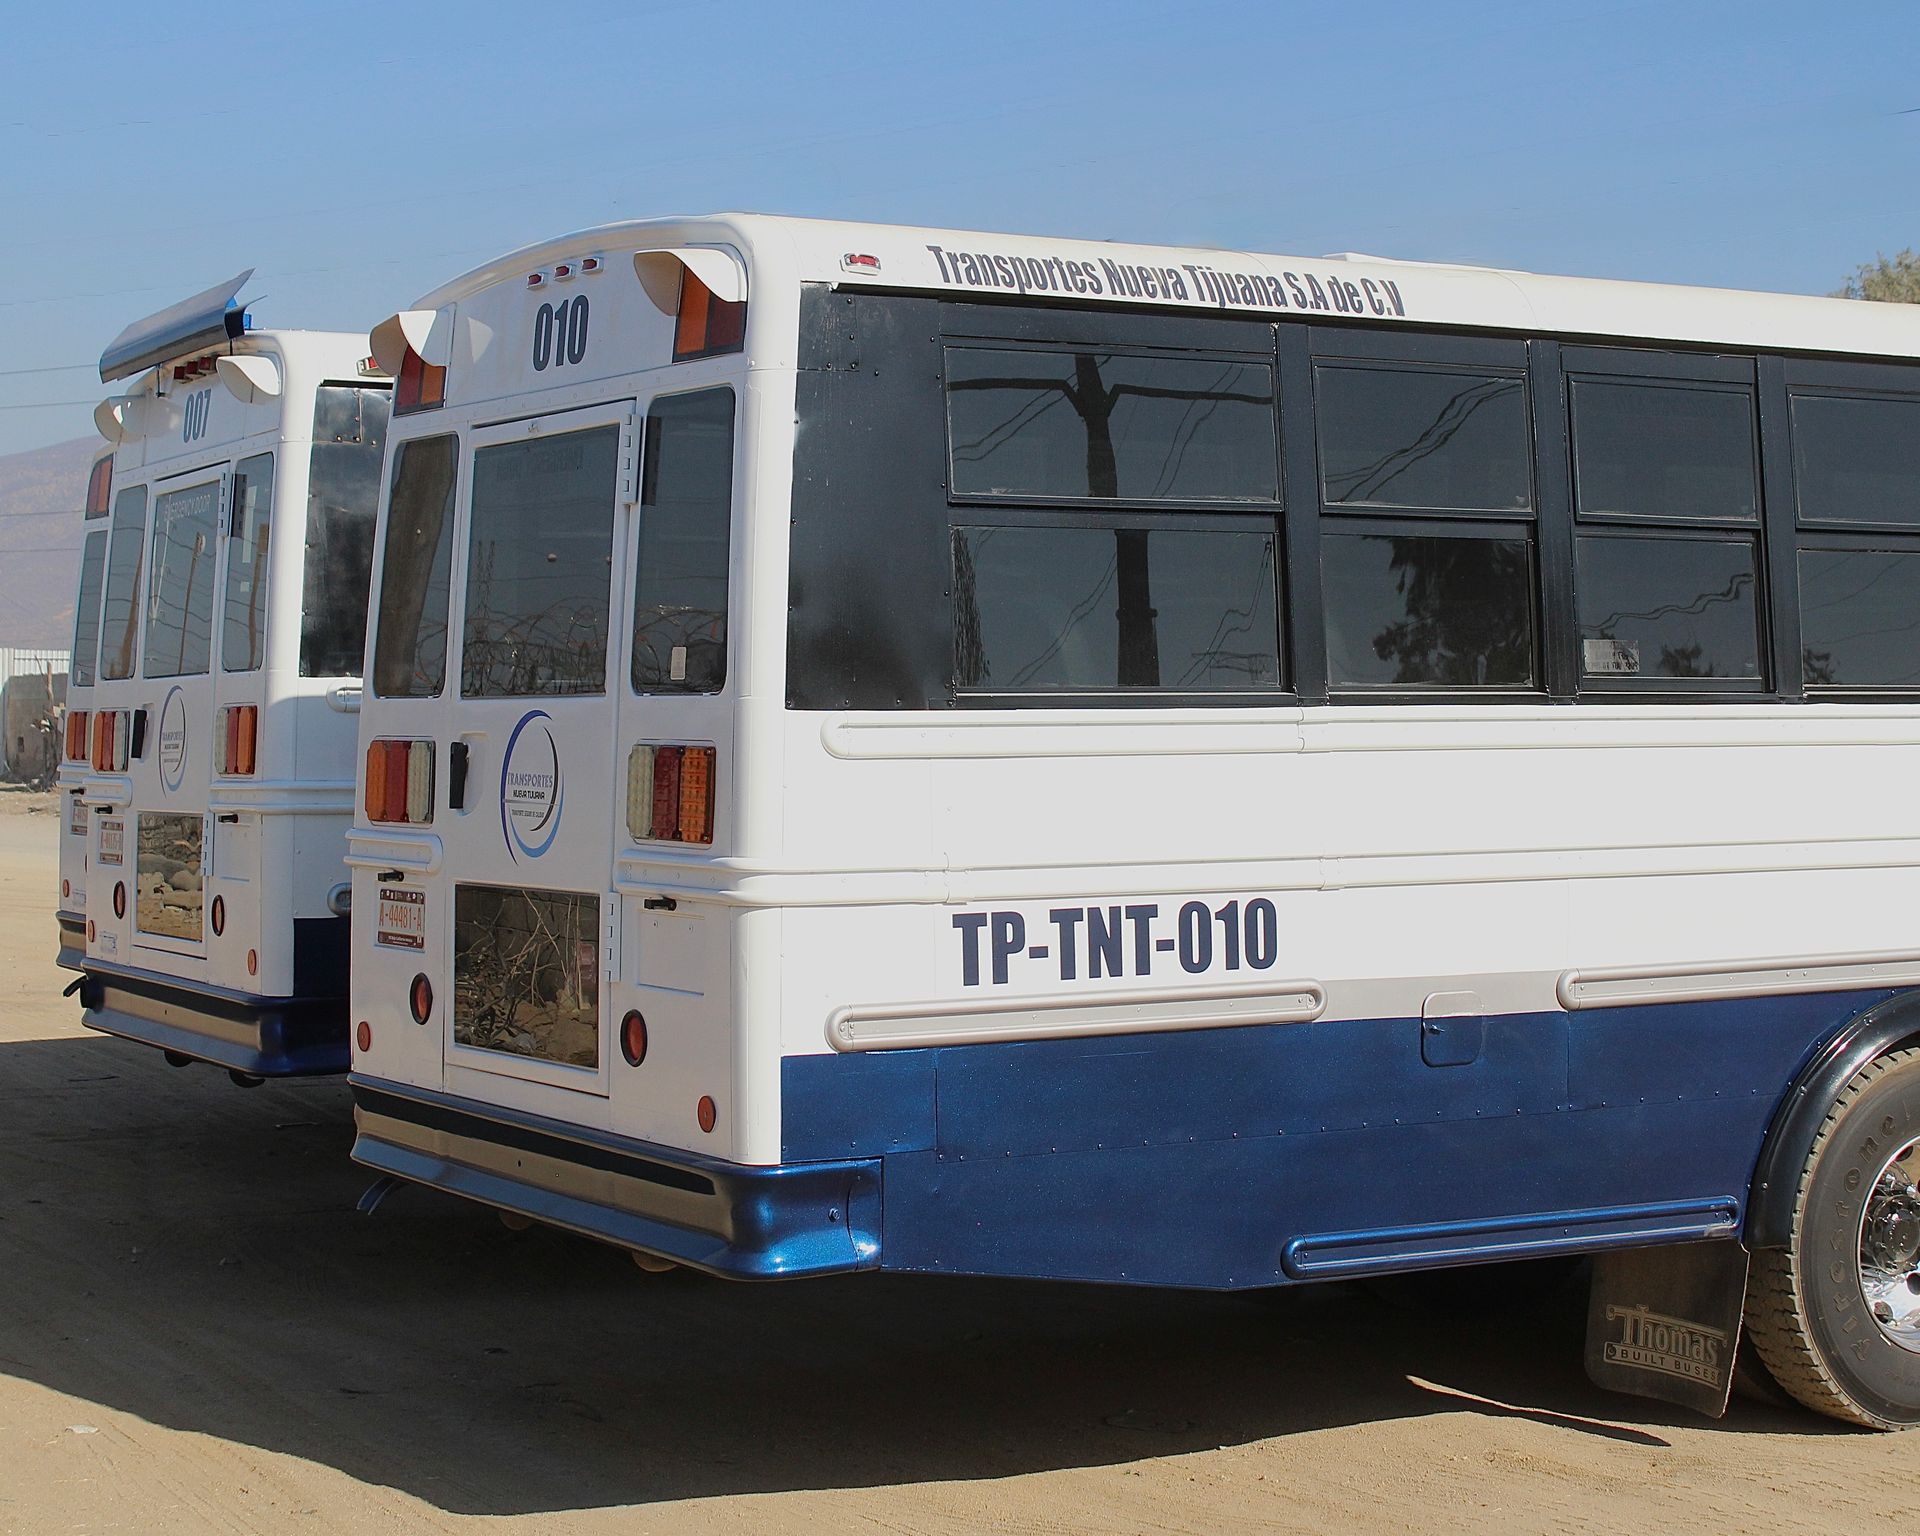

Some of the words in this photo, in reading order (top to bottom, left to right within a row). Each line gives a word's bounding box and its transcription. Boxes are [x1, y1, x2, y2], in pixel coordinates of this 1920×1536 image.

[926, 246, 1104, 295] Transportes
[1098, 258, 1189, 300] Nueva
[1182, 265, 1287, 308] Tijuana
[1283, 272, 1330, 311] S.A
[1327, 275, 1364, 313] de
[1360, 278, 1406, 317] C.V
[532, 294, 589, 372] 010
[183, 388, 211, 443] 007
[507, 772, 553, 788] TRANSPORTES
[952, 897, 1278, 987] TP-TNT-010
[1606, 1304, 1728, 1367] Thomas
[1620, 1349, 1666, 1366] BUILT
[1673, 1364, 1717, 1381] BUSES
